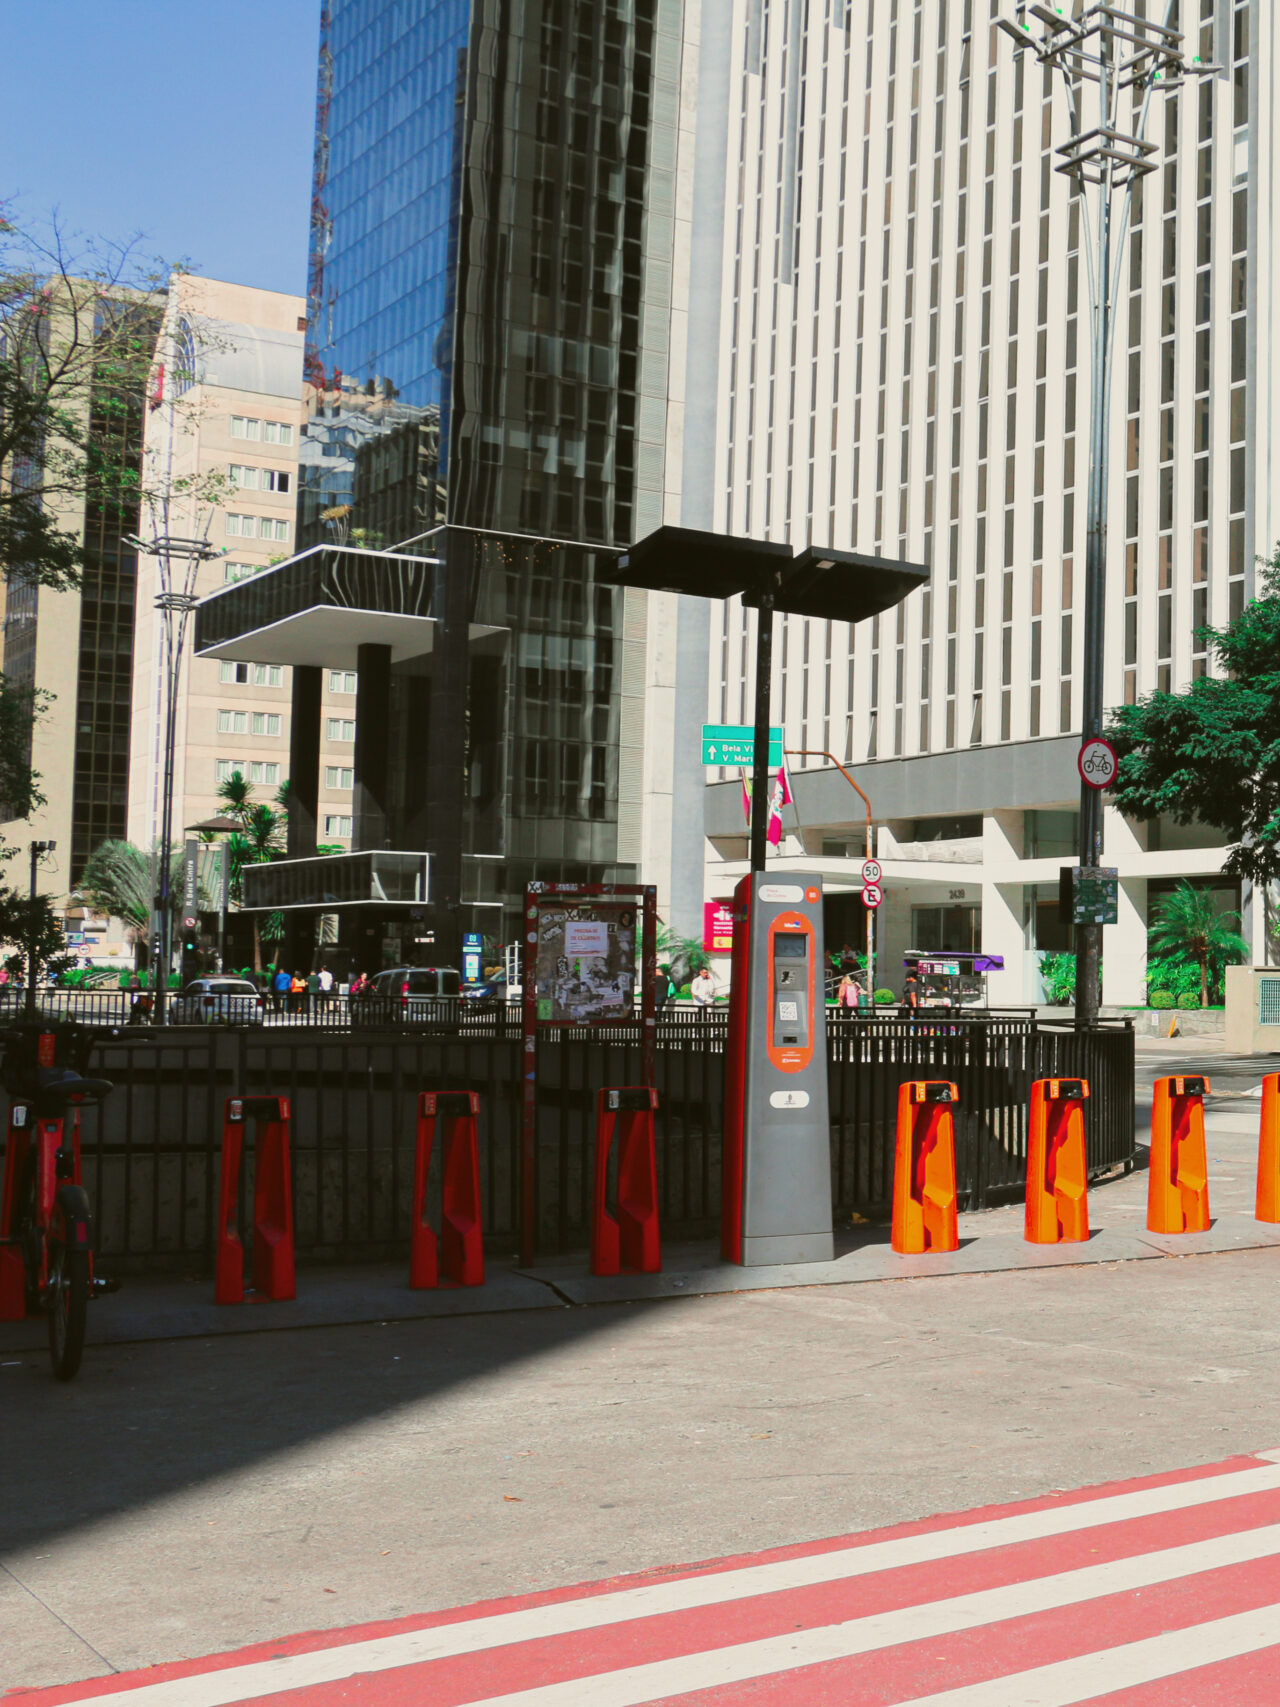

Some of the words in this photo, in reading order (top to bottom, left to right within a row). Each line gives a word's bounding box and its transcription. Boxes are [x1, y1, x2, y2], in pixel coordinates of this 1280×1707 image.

[722, 744, 741, 752] Bela
[186, 860, 194, 882] Cintra
[865, 866, 879, 877] 50
[868, 889, 877, 902] E
[949, 889, 966, 900] 2439
